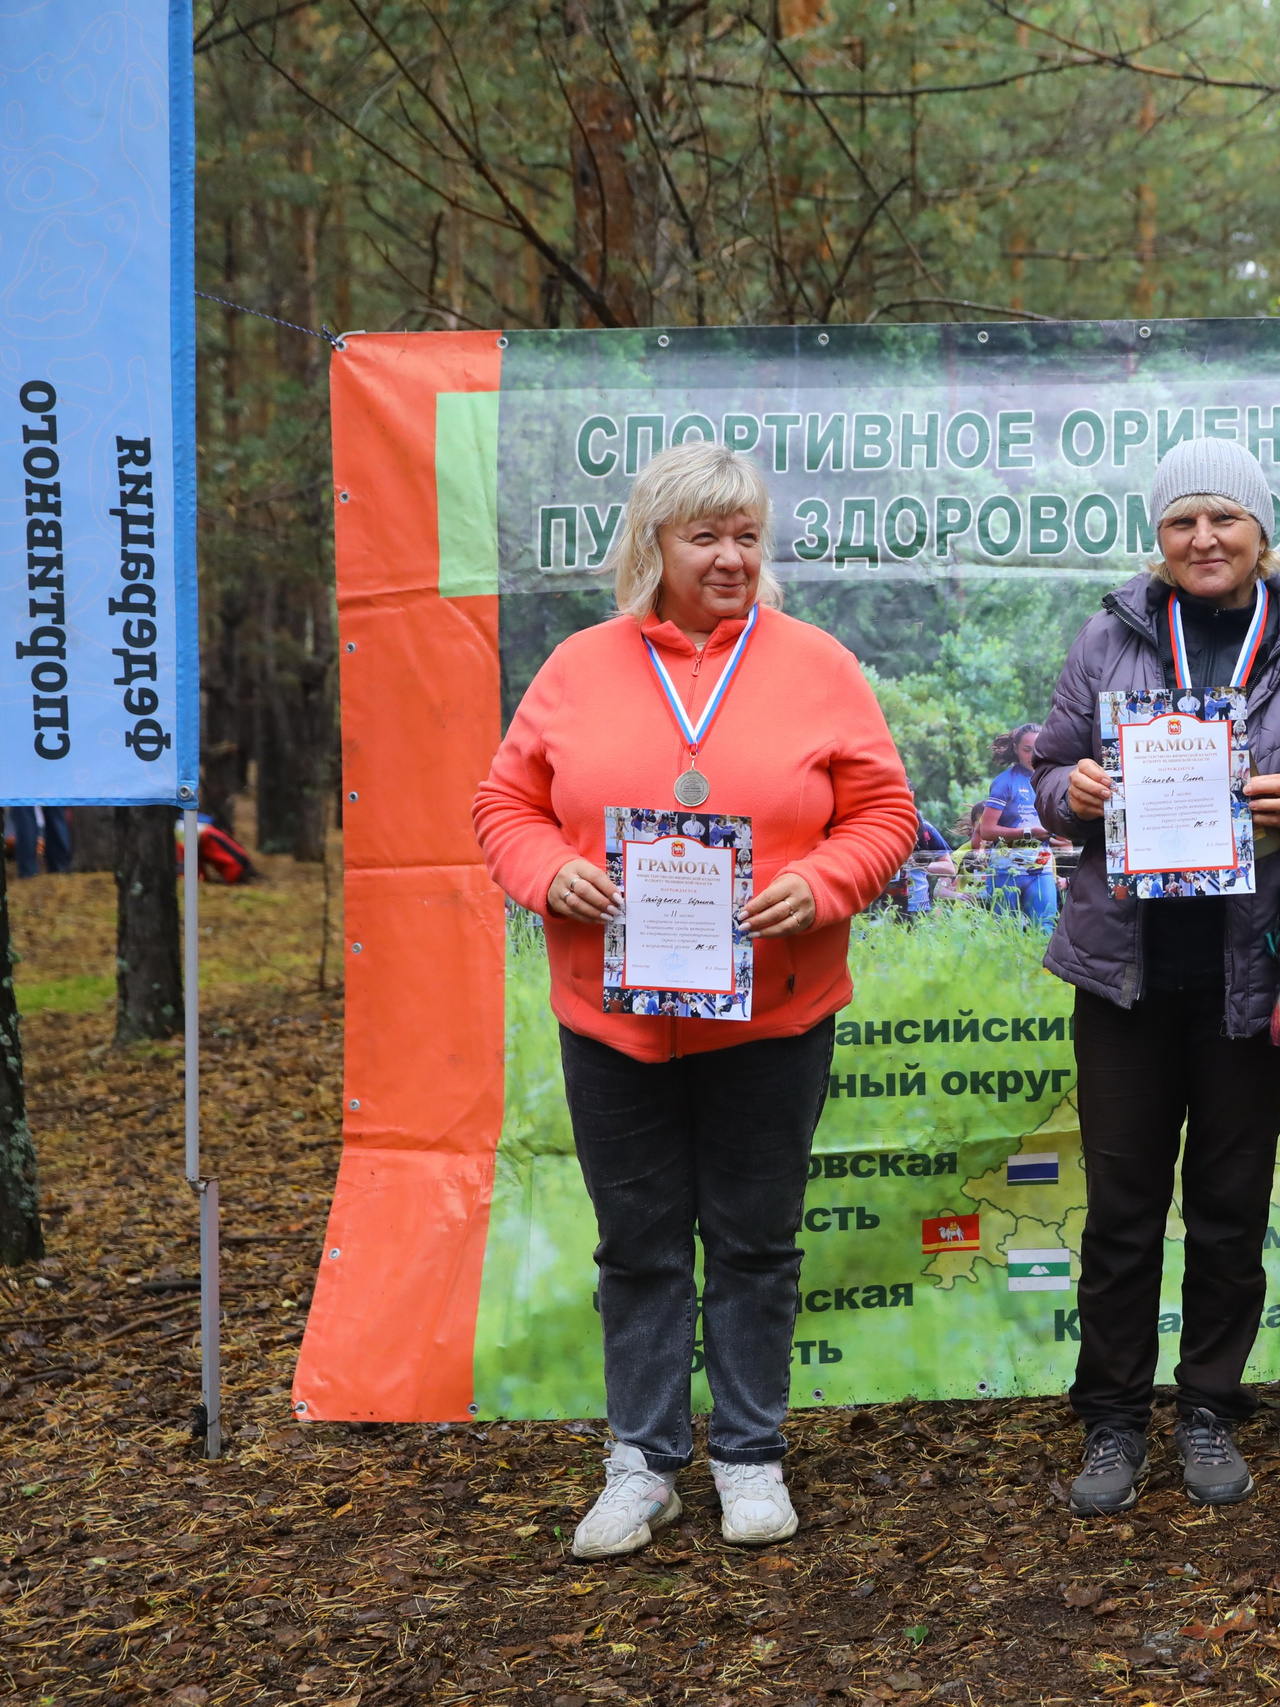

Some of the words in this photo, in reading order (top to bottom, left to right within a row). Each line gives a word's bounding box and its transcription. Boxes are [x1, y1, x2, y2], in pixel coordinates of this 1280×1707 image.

[540, 504, 625, 569] ПУ
[794, 489, 1156, 570] ЗДОРОВОМ
[1134, 737, 1217, 753] ГРАМОТА
[636, 857, 720, 876] ГРАМОТА
[836, 1009, 1075, 1046] ансийски
[830, 1063, 926, 1099] ный
[941, 1069, 1071, 1103] округ
[808, 1152, 957, 1180] овская
[800, 1206, 880, 1232] сть
[799, 1283, 914, 1314] ская
